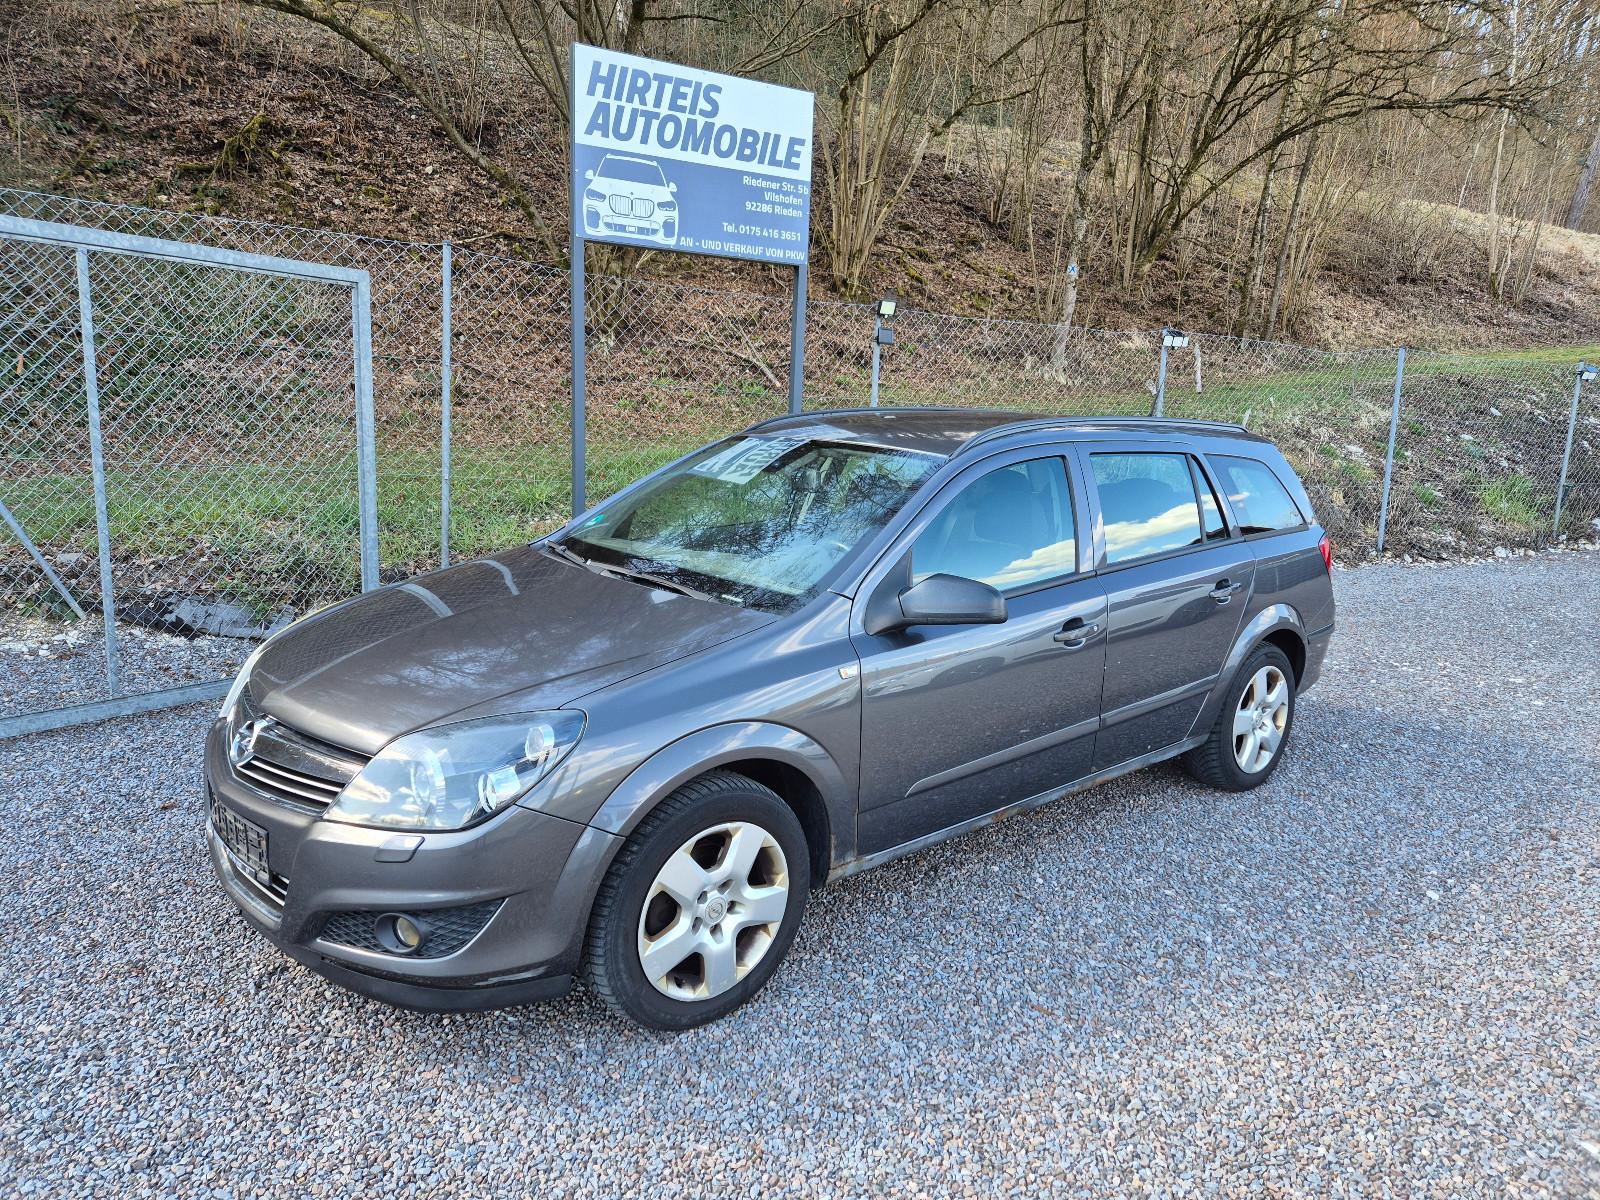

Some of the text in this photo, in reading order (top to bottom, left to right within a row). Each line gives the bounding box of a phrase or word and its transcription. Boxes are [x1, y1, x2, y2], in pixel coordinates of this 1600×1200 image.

[586, 60, 723, 119] HIRTEIS
[584, 100, 806, 171] AUTOMOBILE
[743, 175, 809, 195] Riedener Str. 5b
[764, 191, 803, 206] Vilshofen
[745, 201, 802, 218] 92286 Rieden
[722, 222, 801, 242] Tel. 0175 416 3651
[679, 236, 693, 247] AN
[701, 239, 722, 251] UND
[723, 242, 764, 255] VERKAUF
[765, 247, 784, 259] VON
[785, 249, 805, 261] PKW
